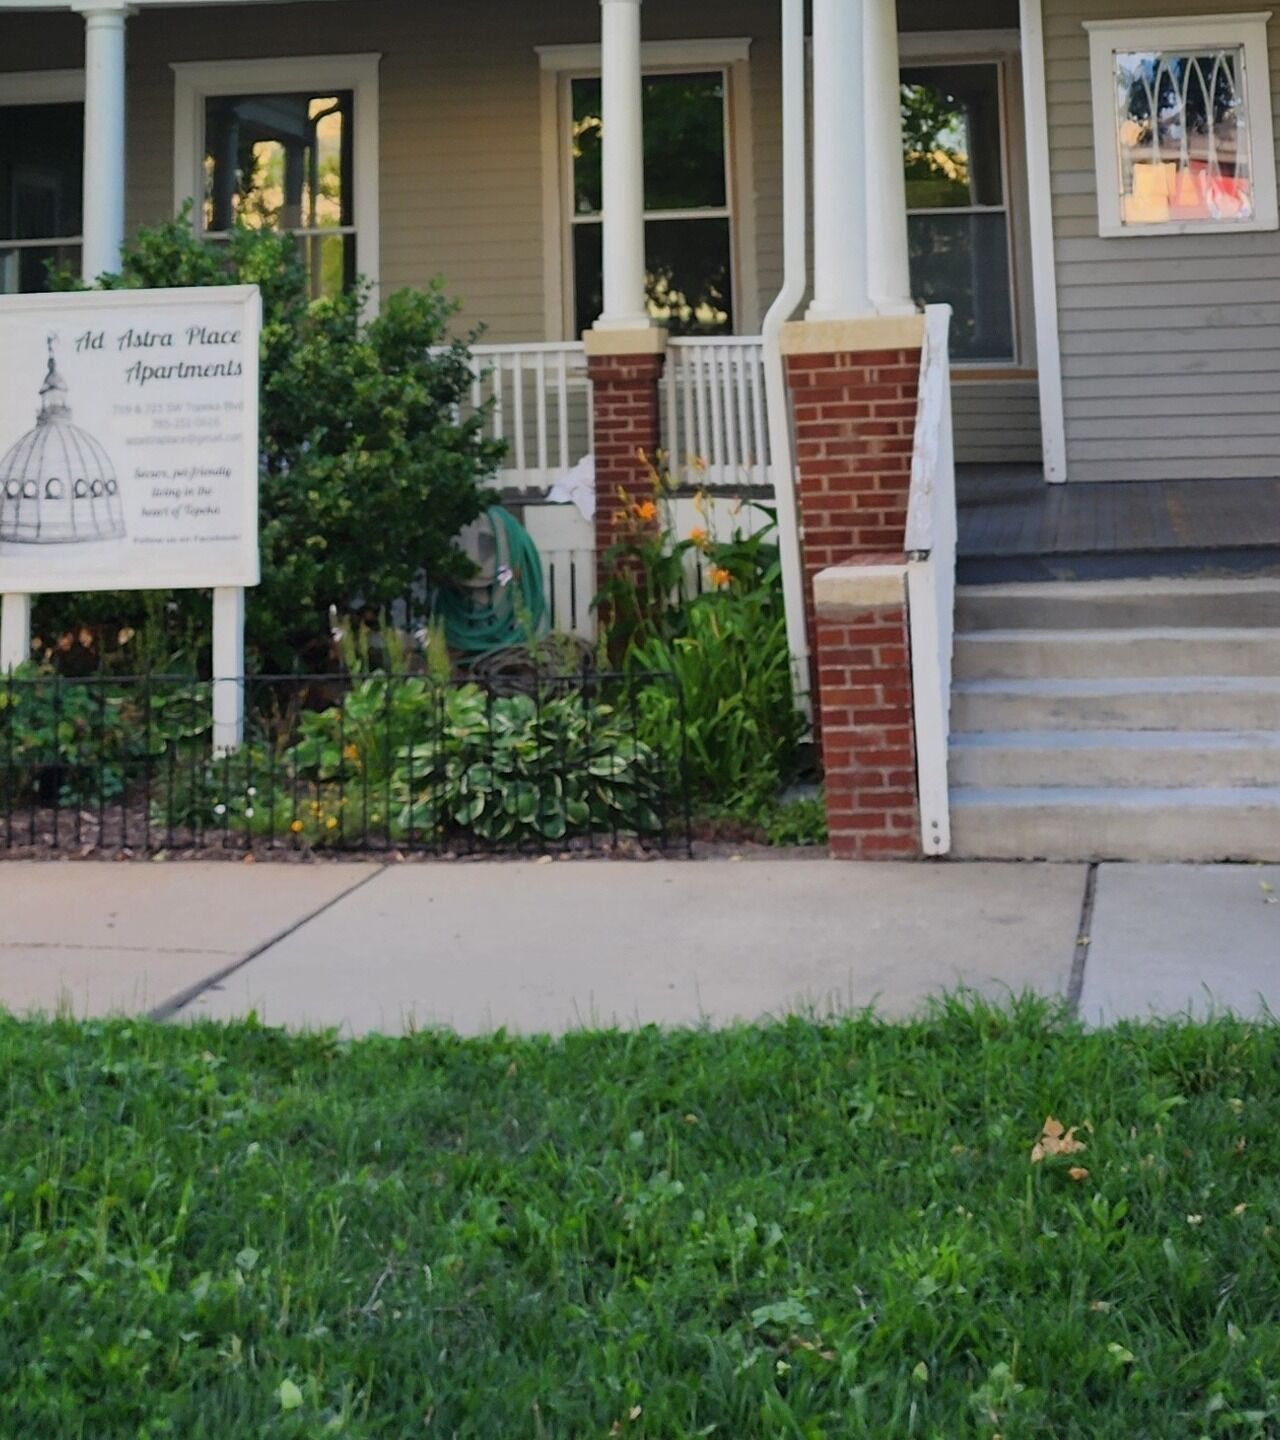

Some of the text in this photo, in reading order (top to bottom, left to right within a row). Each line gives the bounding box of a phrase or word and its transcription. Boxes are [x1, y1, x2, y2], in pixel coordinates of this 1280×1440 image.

[75, 324, 242, 353] Ad Astra Place
[125, 359, 243, 387] Apartments
